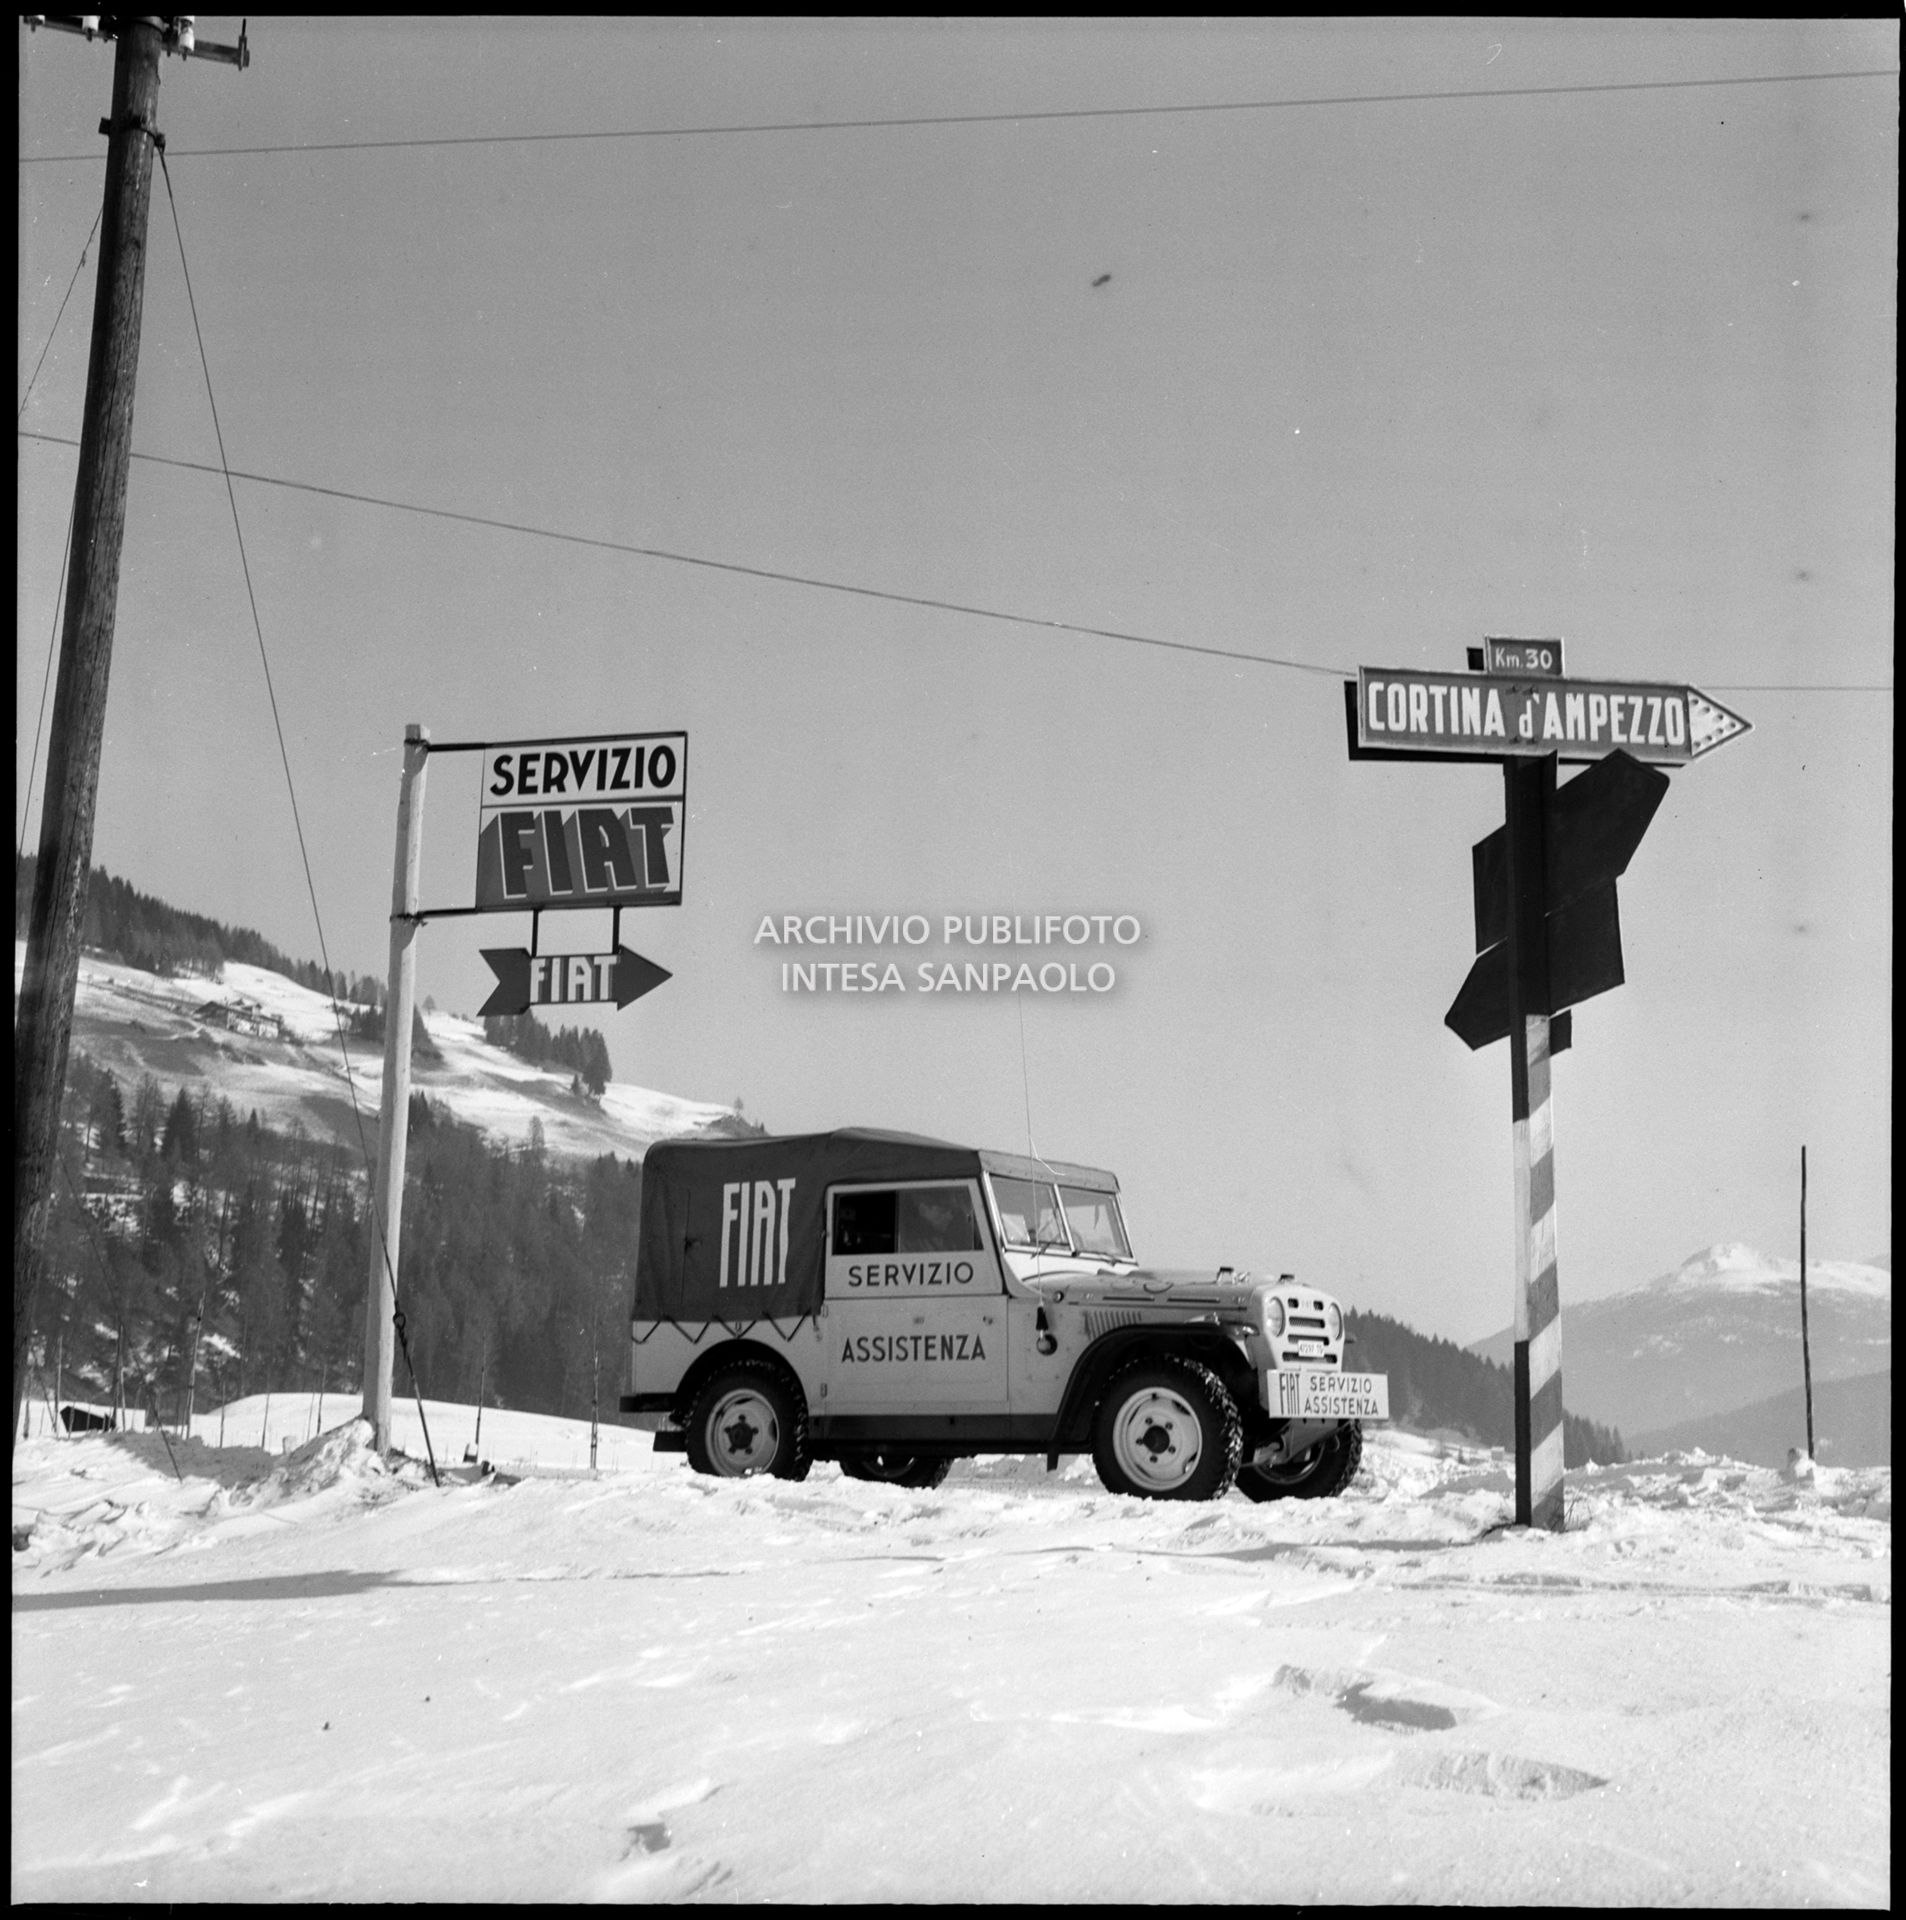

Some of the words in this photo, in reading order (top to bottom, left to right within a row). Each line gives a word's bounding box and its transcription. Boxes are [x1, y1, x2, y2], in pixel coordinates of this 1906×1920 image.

[1526, 648, 1553, 670] 30
[1367, 681, 1506, 737] CORTINA
[1518, 692, 1687, 746] d'AMPEZZO
[490, 745, 676, 796] SERVIZIO
[497, 806, 675, 899] FIAT
[530, 954, 619, 1003] FIAT
[719, 1177, 796, 1288] FIAT
[848, 1261, 974, 1287] SERVIZIO
[841, 1334, 987, 1363] ASSISTENZA
[1279, 1373, 1300, 1416] FIAT
[1304, 1396, 1379, 1416] ASSISTENZA
[1310, 1376, 1372, 1394] SERVIZIO
